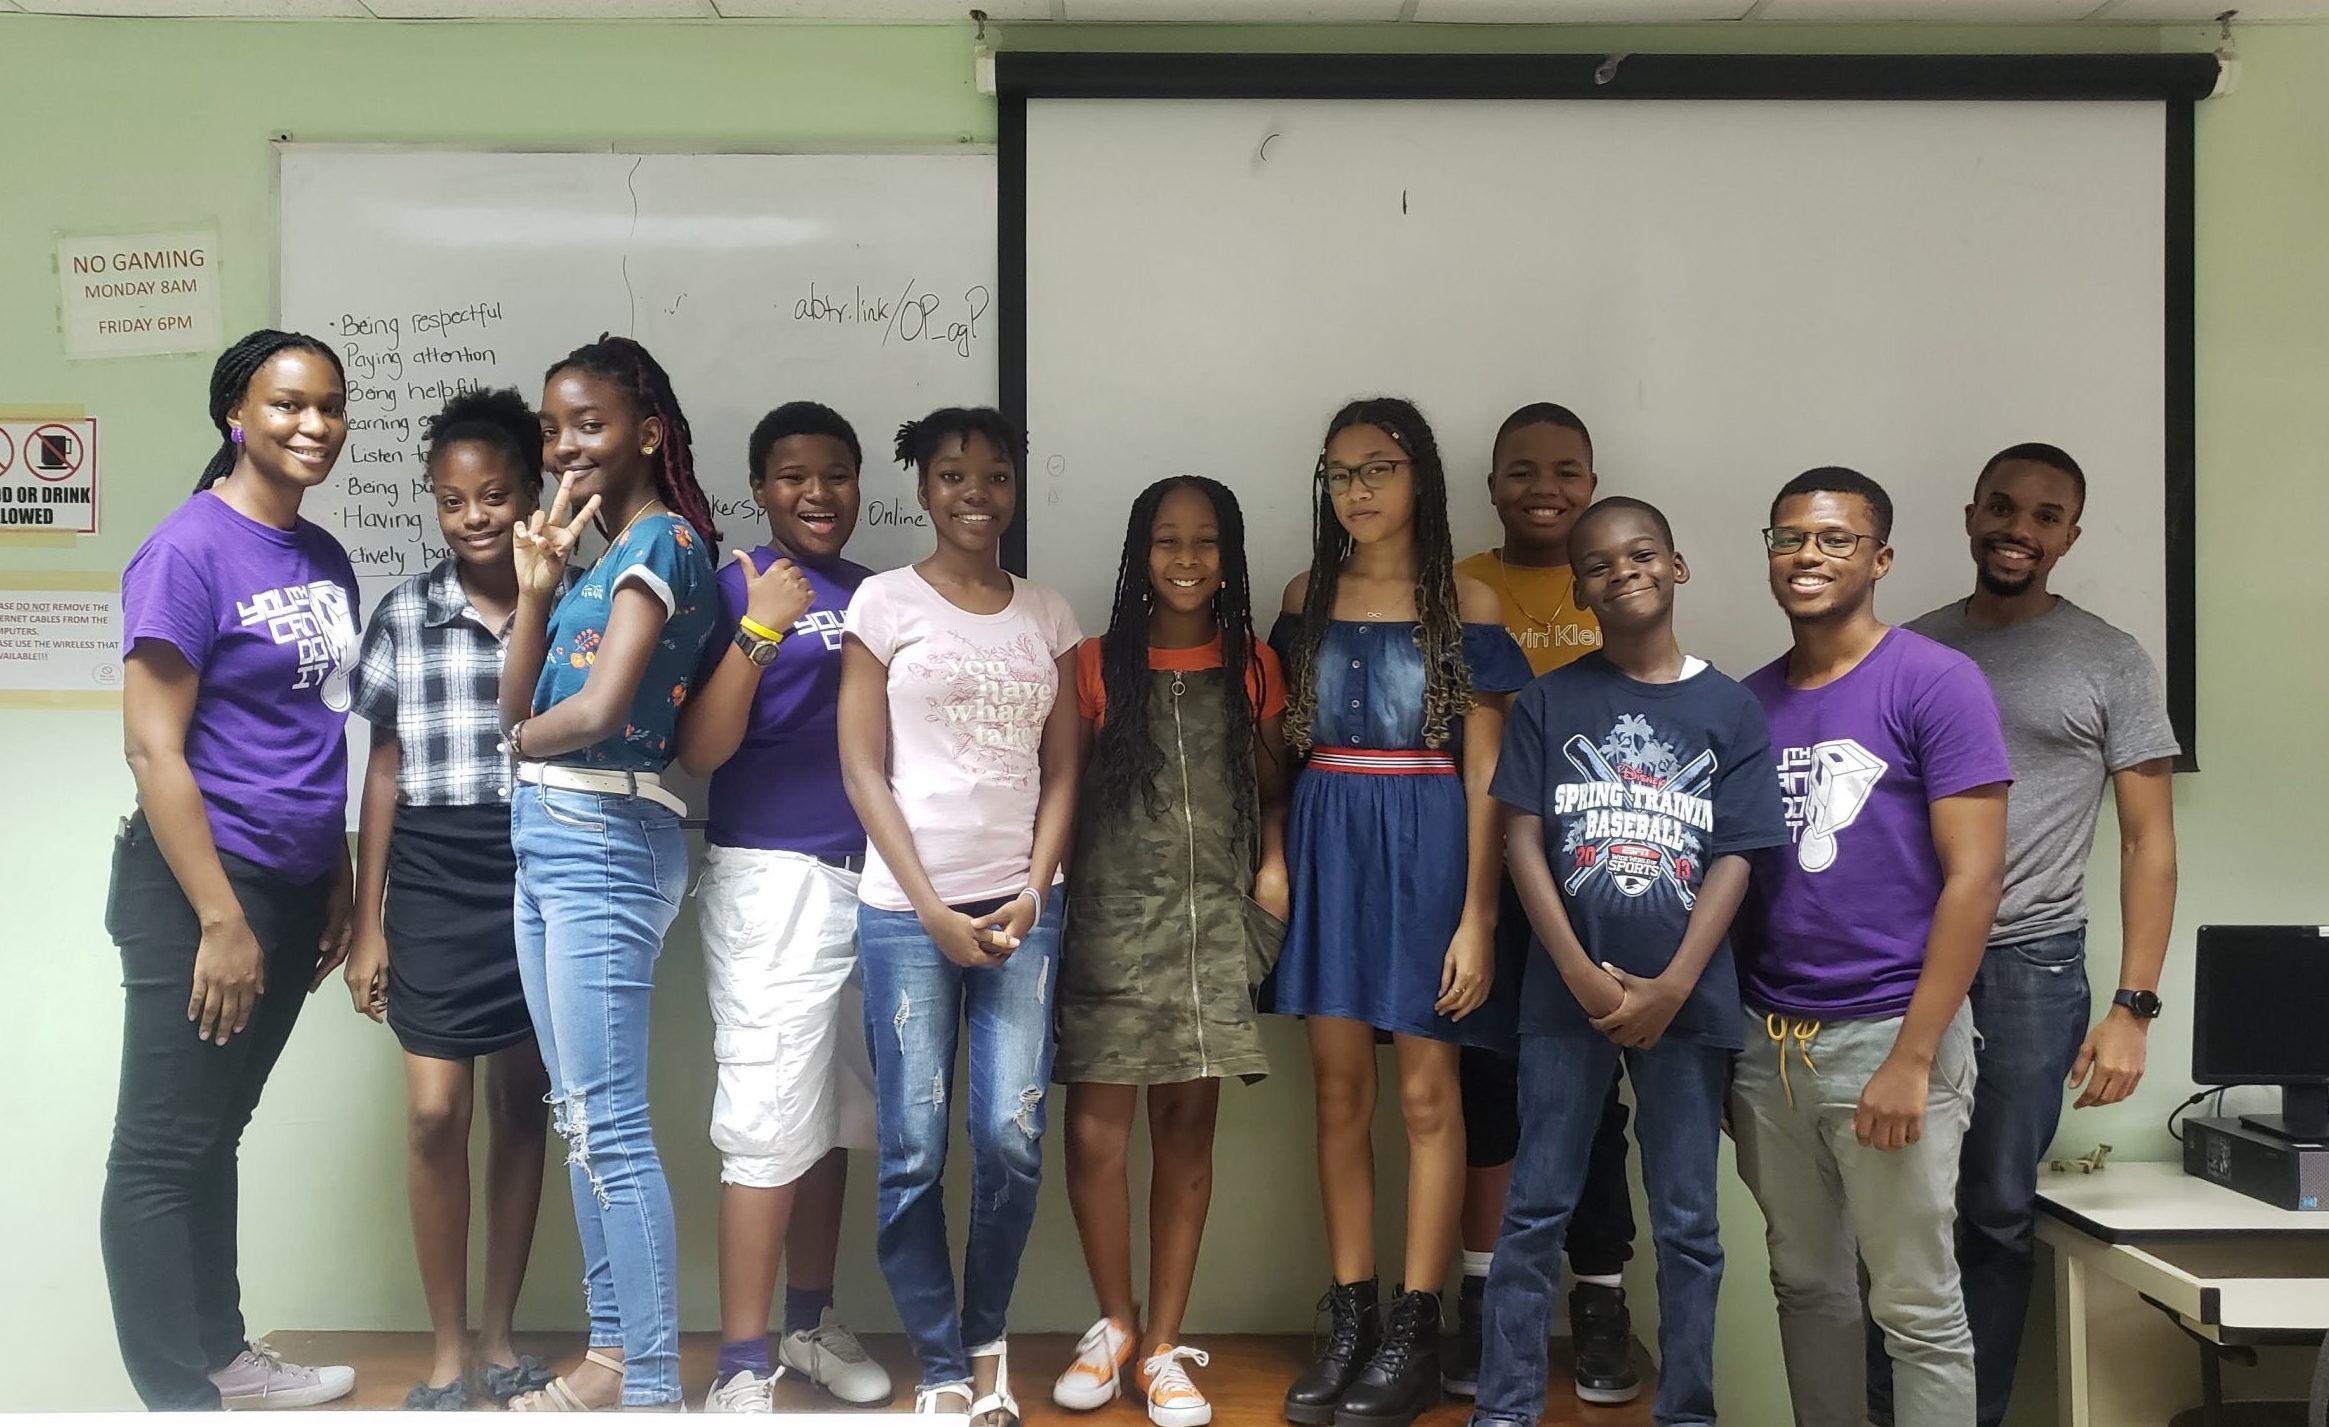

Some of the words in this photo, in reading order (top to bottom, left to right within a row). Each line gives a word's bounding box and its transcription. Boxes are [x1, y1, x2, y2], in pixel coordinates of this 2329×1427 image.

[73, 255, 106, 274] NO
[112, 249, 205, 272] GAMING
[85, 281, 156, 299] MONDAY
[160, 279, 198, 295] 8AM
[99, 318, 152, 335] FRIDAY
[157, 315, 193, 332] 6PM
[340, 313, 400, 351] Being
[411, 302, 502, 338] respectful
[343, 342, 403, 381] Paying
[413, 346, 497, 366] attention
[407, 377, 480, 406] helpful
[350, 443, 404, 463] Listen
[17, 486, 38, 504] OR
[42, 486, 91, 504] DRINK
[348, 476, 399, 507] Being
[0, 507, 54, 525] LOWED
[343, 504, 423, 543] Having
[868, 498, 928, 527] Online
[16, 602, 30, 611] DO
[32, 603, 51, 611] NOT
[52, 603, 90, 611] REMOVE
[93, 603, 109, 612] THE
[29, 615, 61, 623] CABLES
[63, 615, 89, 624] FROM
[92, 616, 108, 625] THE
[15, 640, 31, 648] USE
[34, 640, 50, 648] THE
[52, 640, 95, 649] WIRELESS
[97, 641, 119, 649] THAT
[1505, 625, 1549, 649] vin
[1555, 623, 1603, 647] Klei
[945, 655, 1011, 682] you
[977, 673, 1051, 704] have
[943, 698, 1029, 723] what
[1554, 782, 1624, 815] SPRING
[1630, 784, 1714, 833] TRAININ
[1585, 809, 1685, 852] BASEBALL
[1575, 844, 1598, 868] 20
[1607, 859, 1660, 878] SPORTS
[1674, 856, 1693, 882] 13
